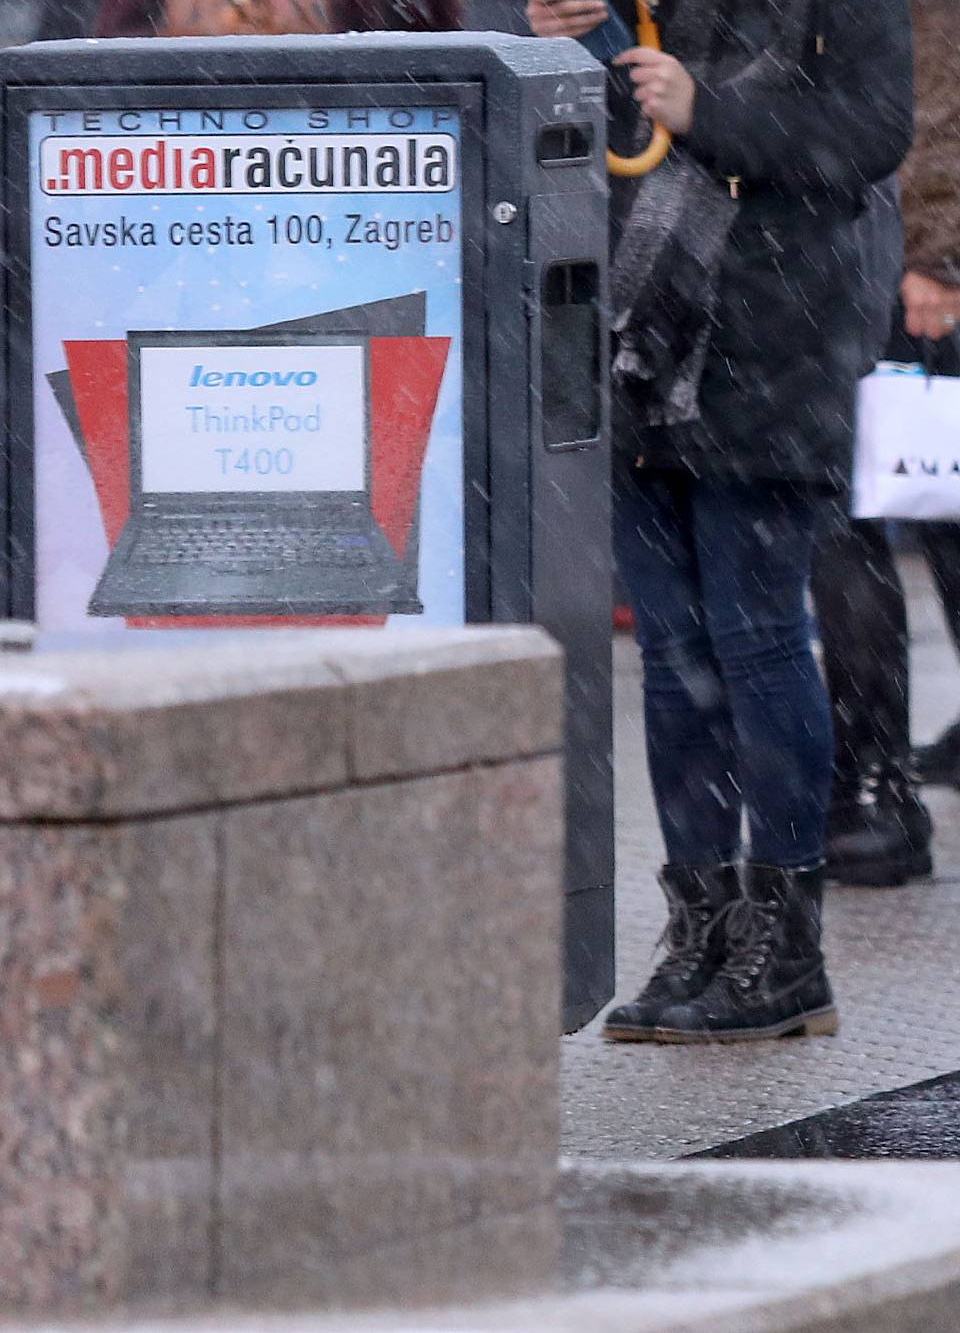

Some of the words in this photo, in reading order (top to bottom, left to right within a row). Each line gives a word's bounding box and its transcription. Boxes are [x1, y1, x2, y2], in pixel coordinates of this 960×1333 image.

[44, 110, 268, 132] TECHNO
[45, 215, 156, 247] Savska
[169, 215, 254, 246] cesta
[266, 214, 333, 250] 100,
[344, 214, 454, 250] Zagreb
[190, 365, 318, 388] lenovo
[214, 447, 294, 475] T400
